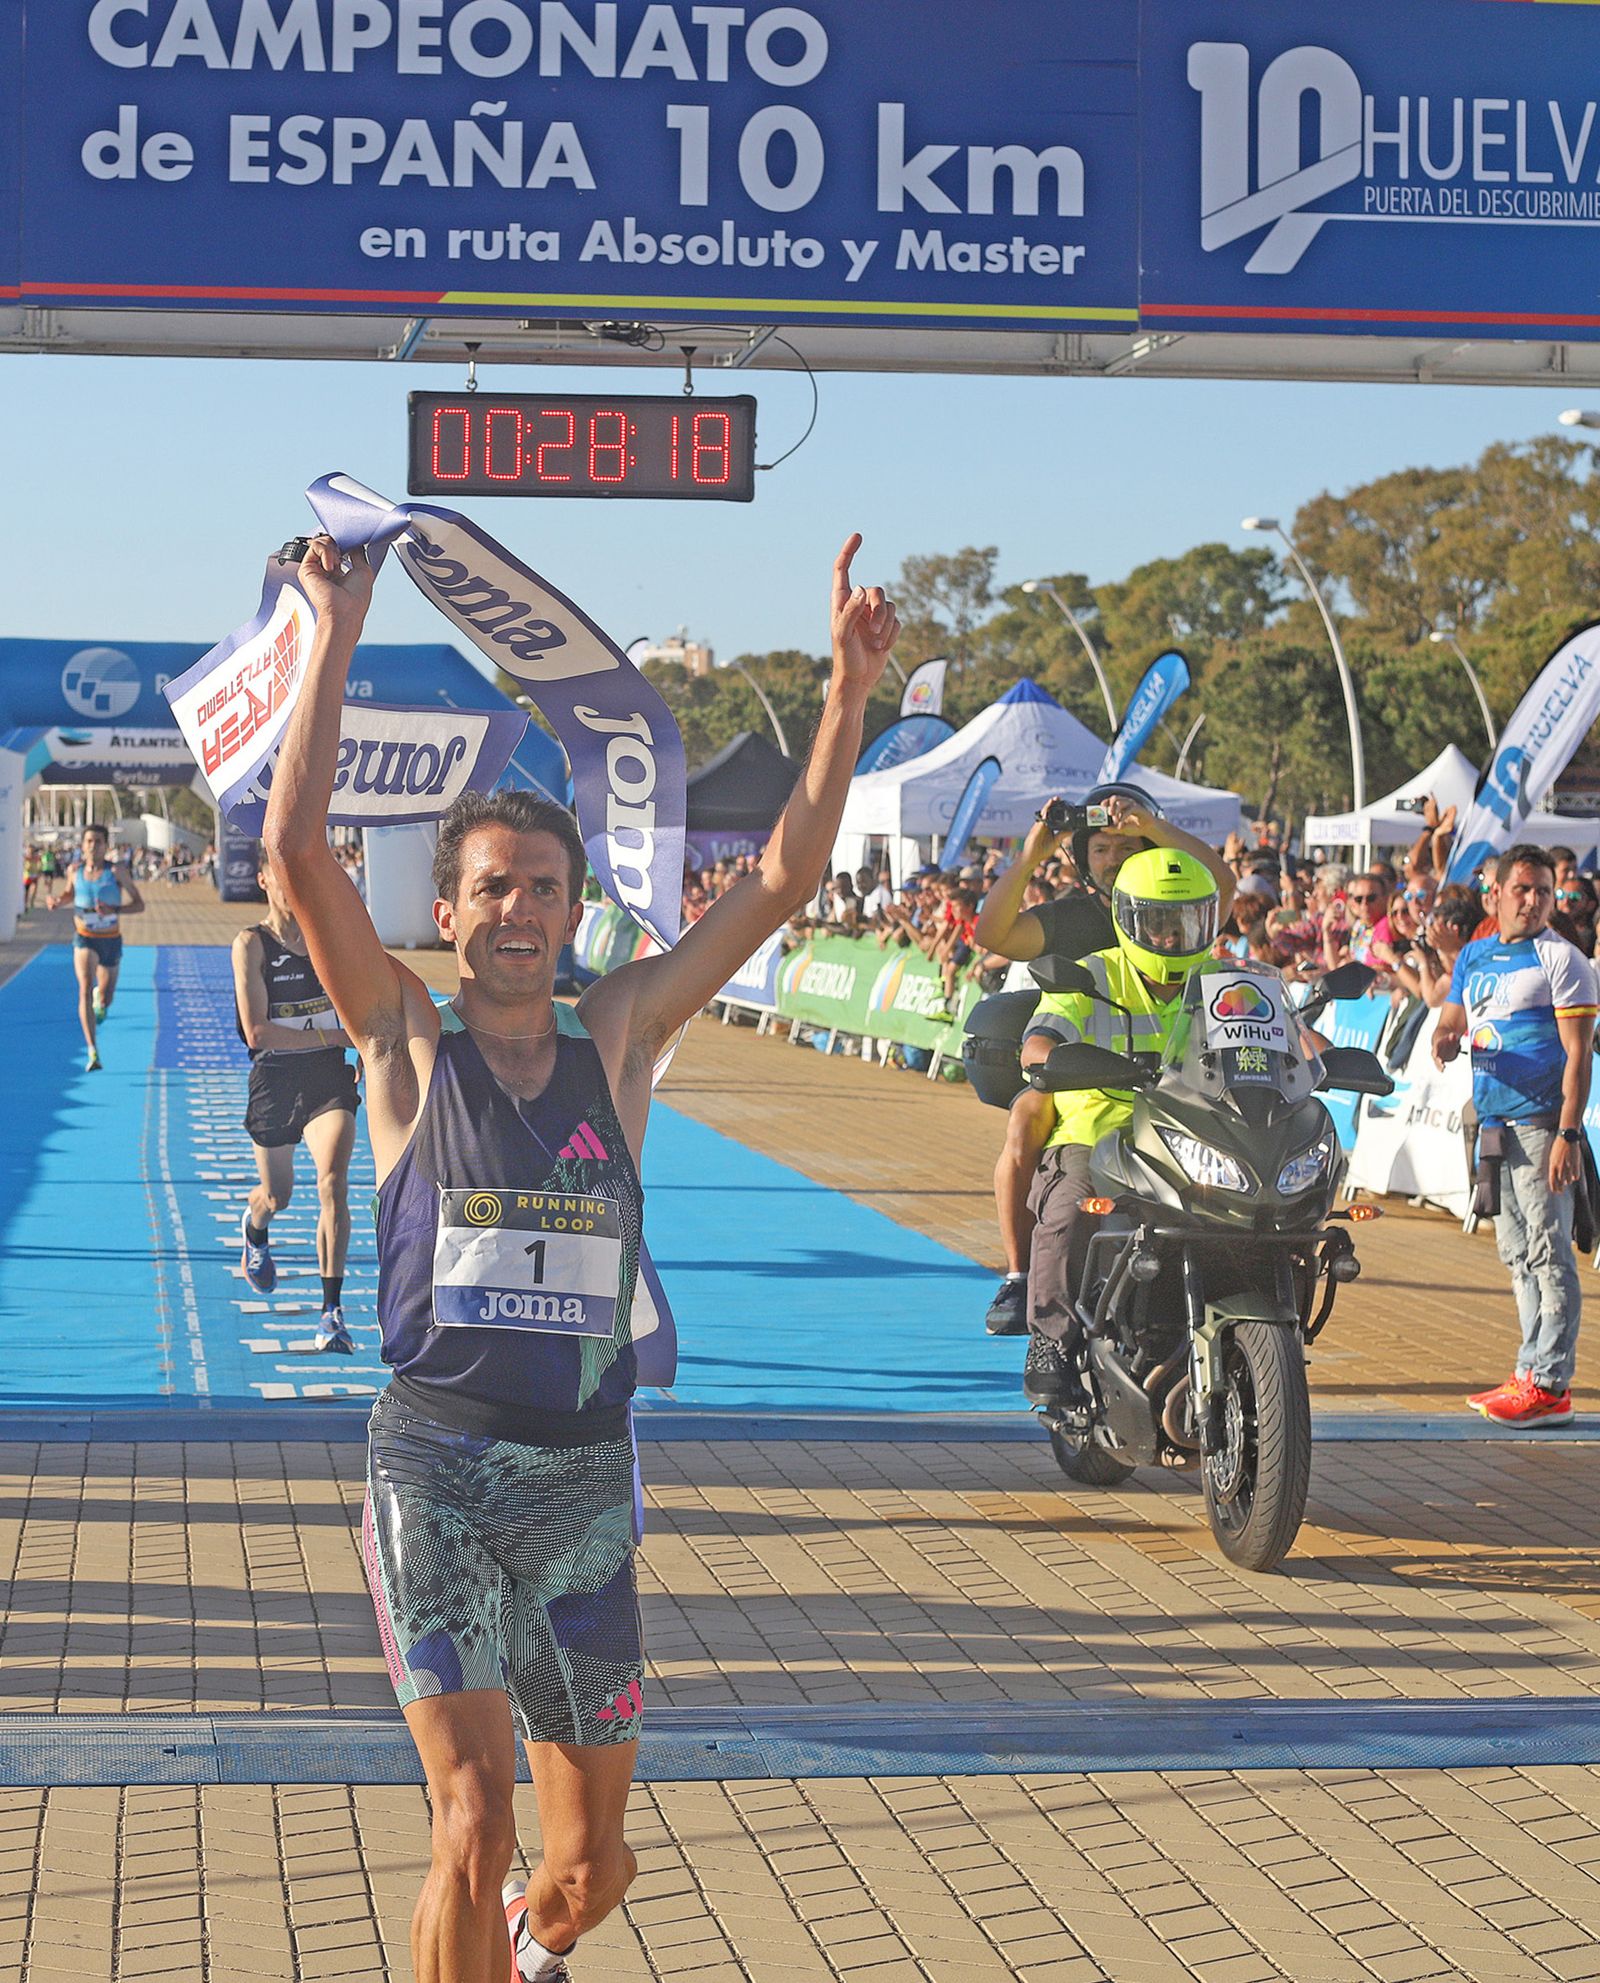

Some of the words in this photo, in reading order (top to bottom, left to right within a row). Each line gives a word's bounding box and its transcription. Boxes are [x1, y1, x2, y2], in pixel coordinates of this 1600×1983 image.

[87, 0, 829, 87] CAMPEONATO
[81, 104, 194, 181] de
[228, 100, 597, 190] ESPAÑA
[666, 103, 825, 213] 10
[876, 102, 1085, 217] km
[1363, 94, 1600, 184] HUELV
[1364, 185, 1434, 214] PUERTA
[1438, 188, 1473, 215] DEL
[359, 222, 427, 259] en
[447, 222, 561, 262] ruta
[578, 217, 825, 269] Absoluto
[841, 239, 879, 282] y
[895, 228, 1086, 275] Master
[197, 646, 272, 728] ATLETISMO
[201, 678, 274, 777] RFEA
[1224, 1024, 1272, 1042] WiHu
[516, 1195, 607, 1216] RUNNING
[540, 1216, 595, 1232] LOOP
[523, 1239, 546, 1285] 1
